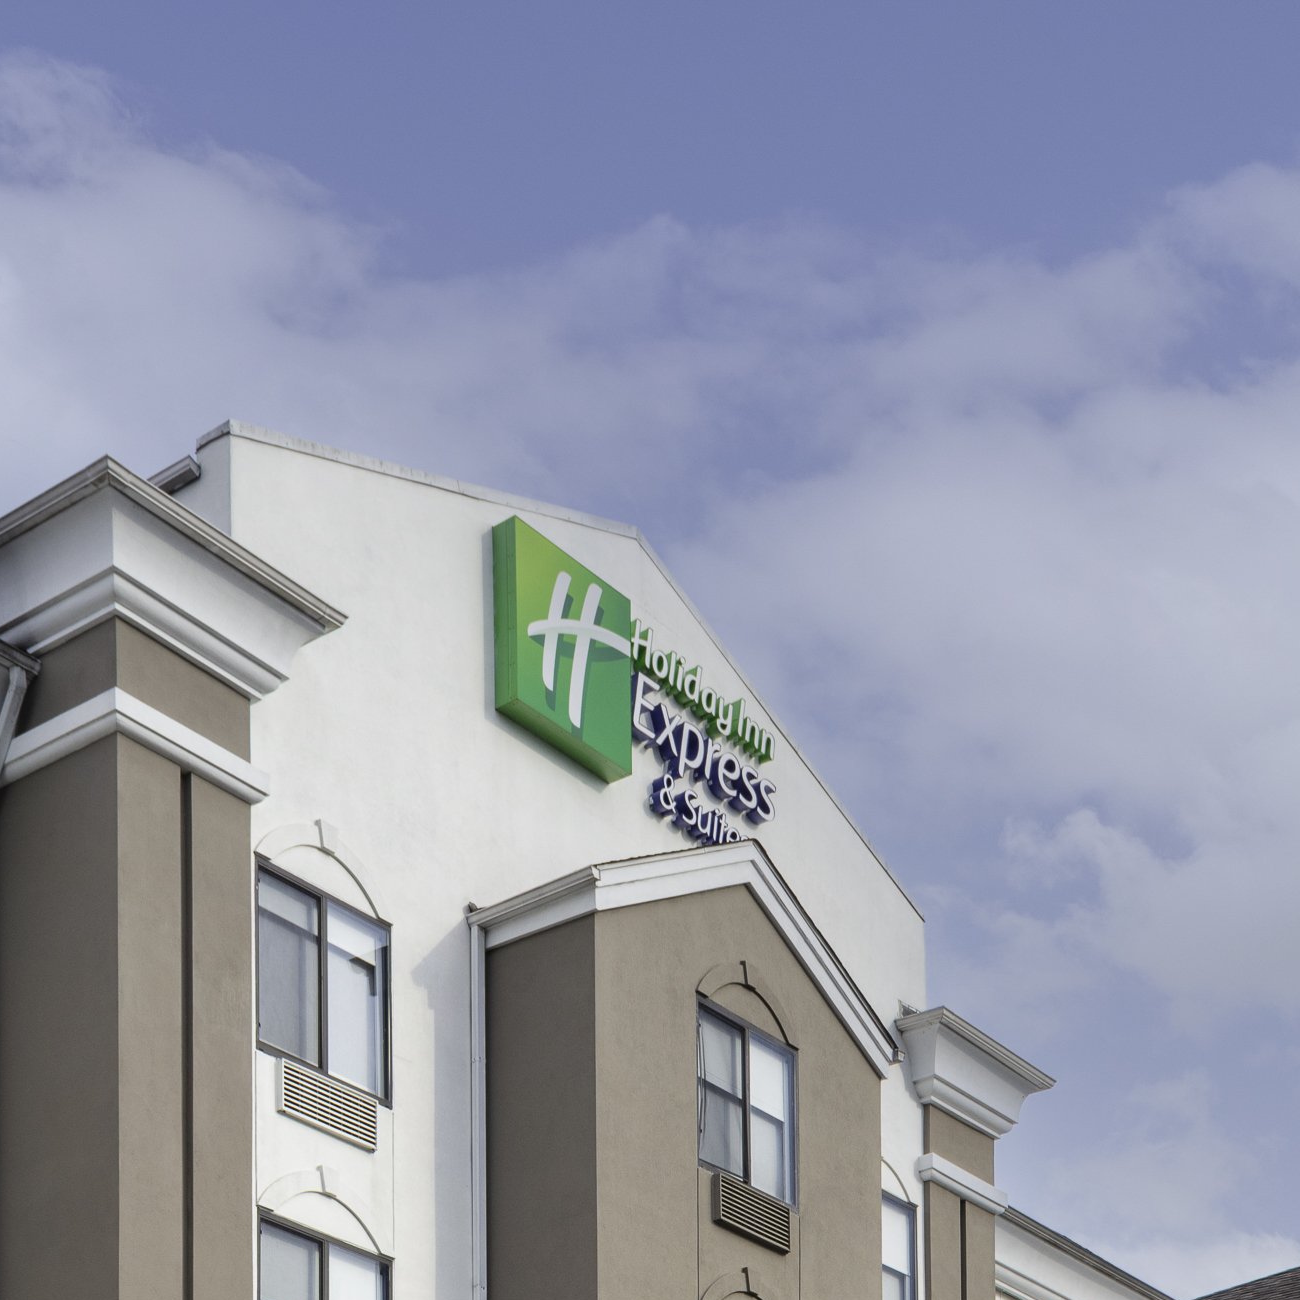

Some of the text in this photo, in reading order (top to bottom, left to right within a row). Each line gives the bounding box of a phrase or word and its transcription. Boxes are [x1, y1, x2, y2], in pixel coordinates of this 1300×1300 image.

[631, 619, 775, 759] Holiday Inn
[633, 672, 776, 821] Express
[659, 774, 676, 813] &
